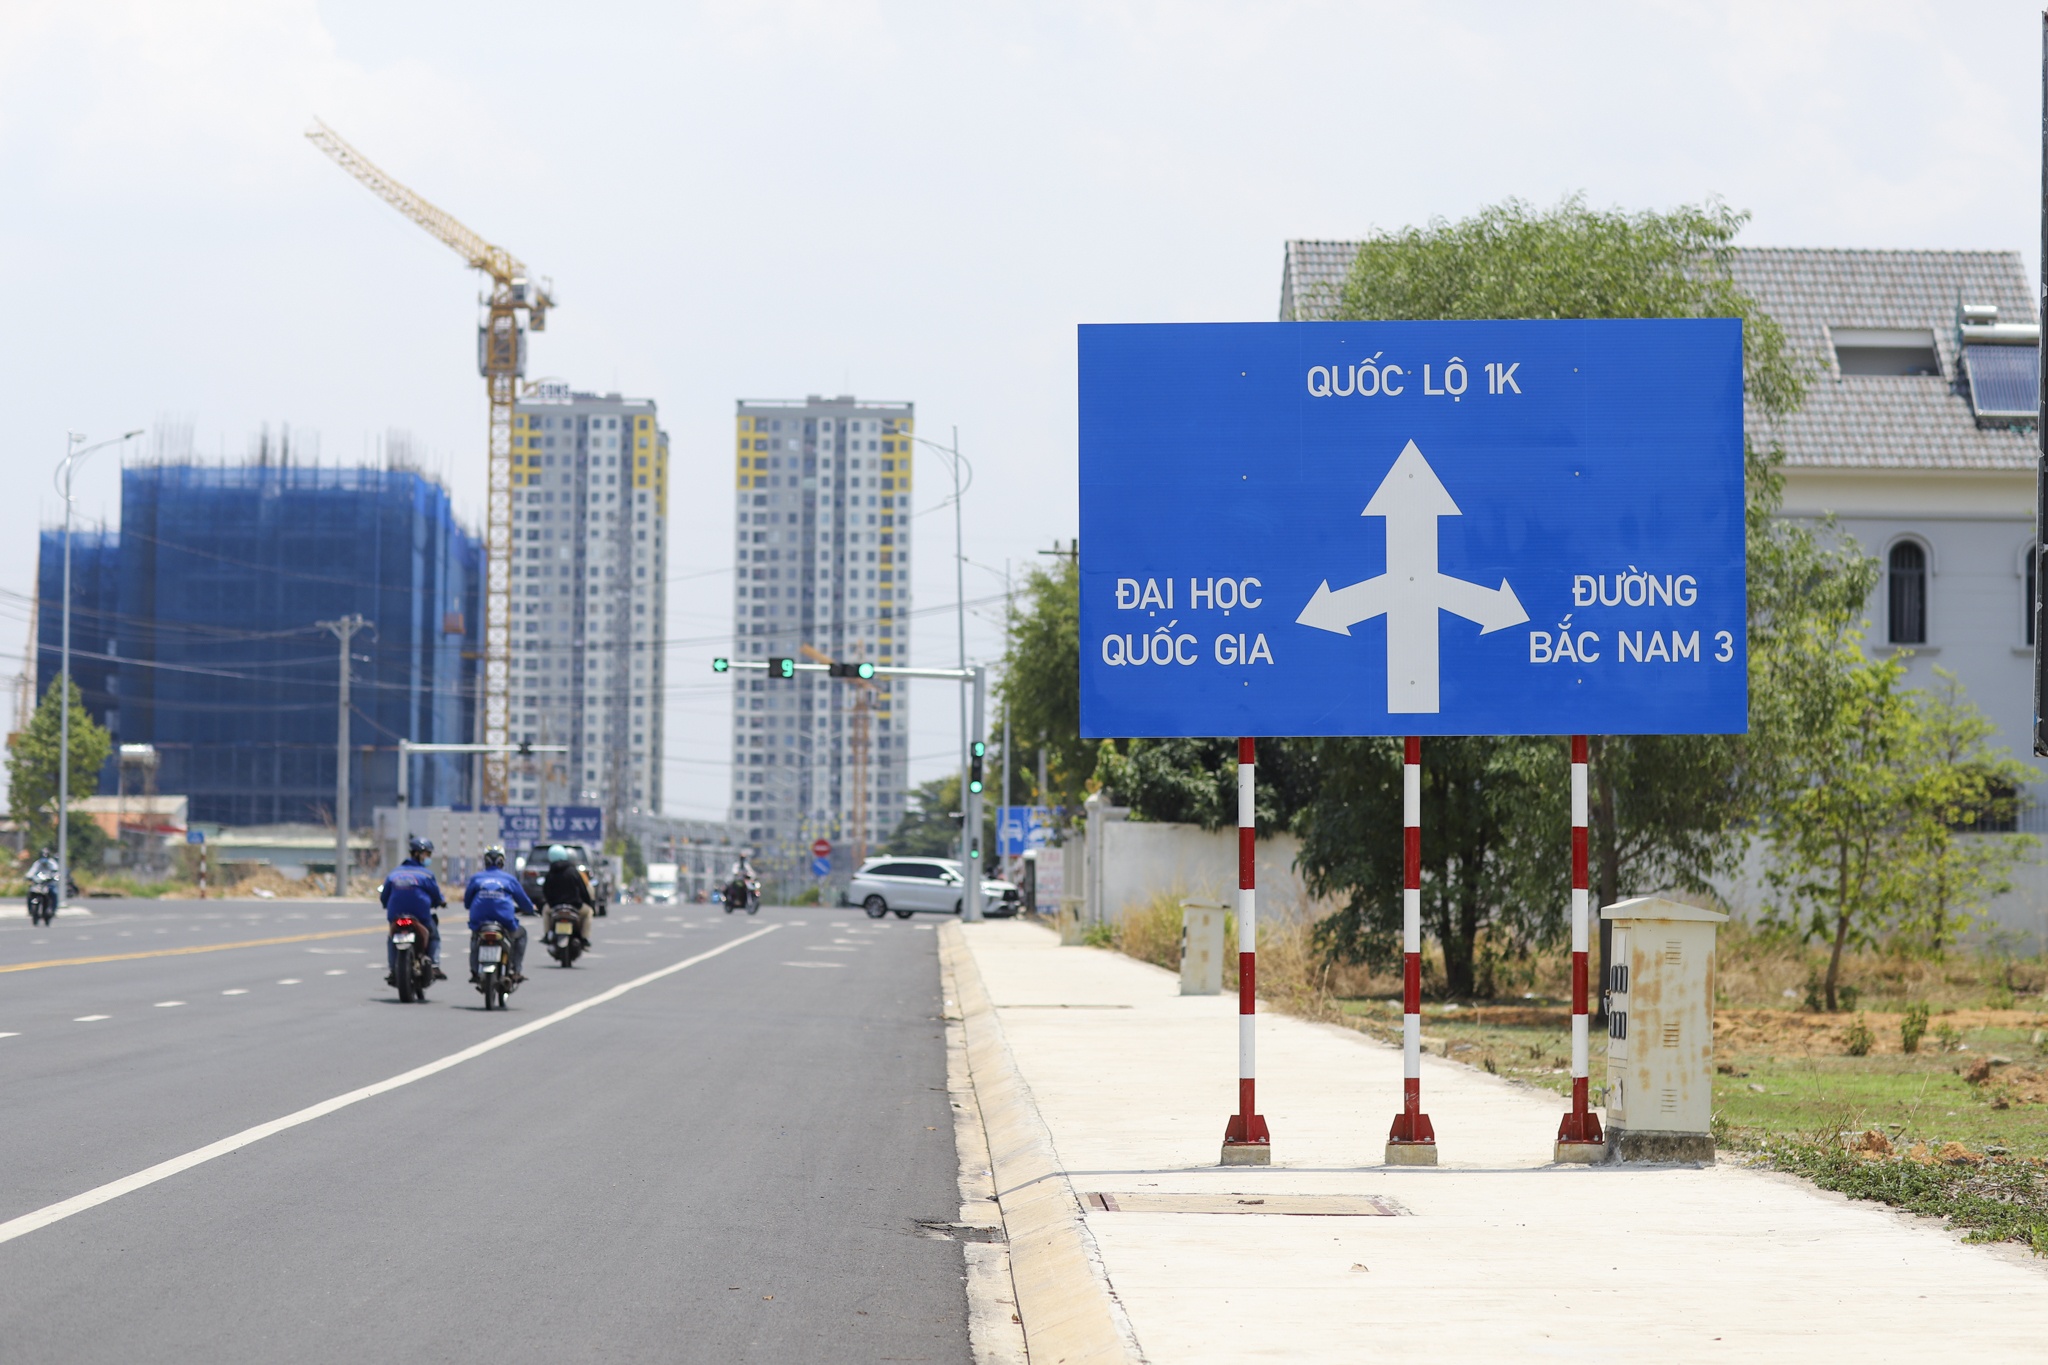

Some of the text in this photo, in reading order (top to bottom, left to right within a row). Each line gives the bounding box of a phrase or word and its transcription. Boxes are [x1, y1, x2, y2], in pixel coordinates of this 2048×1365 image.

[1308, 352, 1522, 402] QUỐC LỘ 1K
[1115, 577, 1263, 616] ĐẠI HỌC
[1572, 565, 1697, 607] ĐƯỜNG
[1103, 620, 1274, 666] QUỐC GIA
[1530, 614, 1734, 663] BẮC NAM 3
[781, 659, 793, 678] 9
